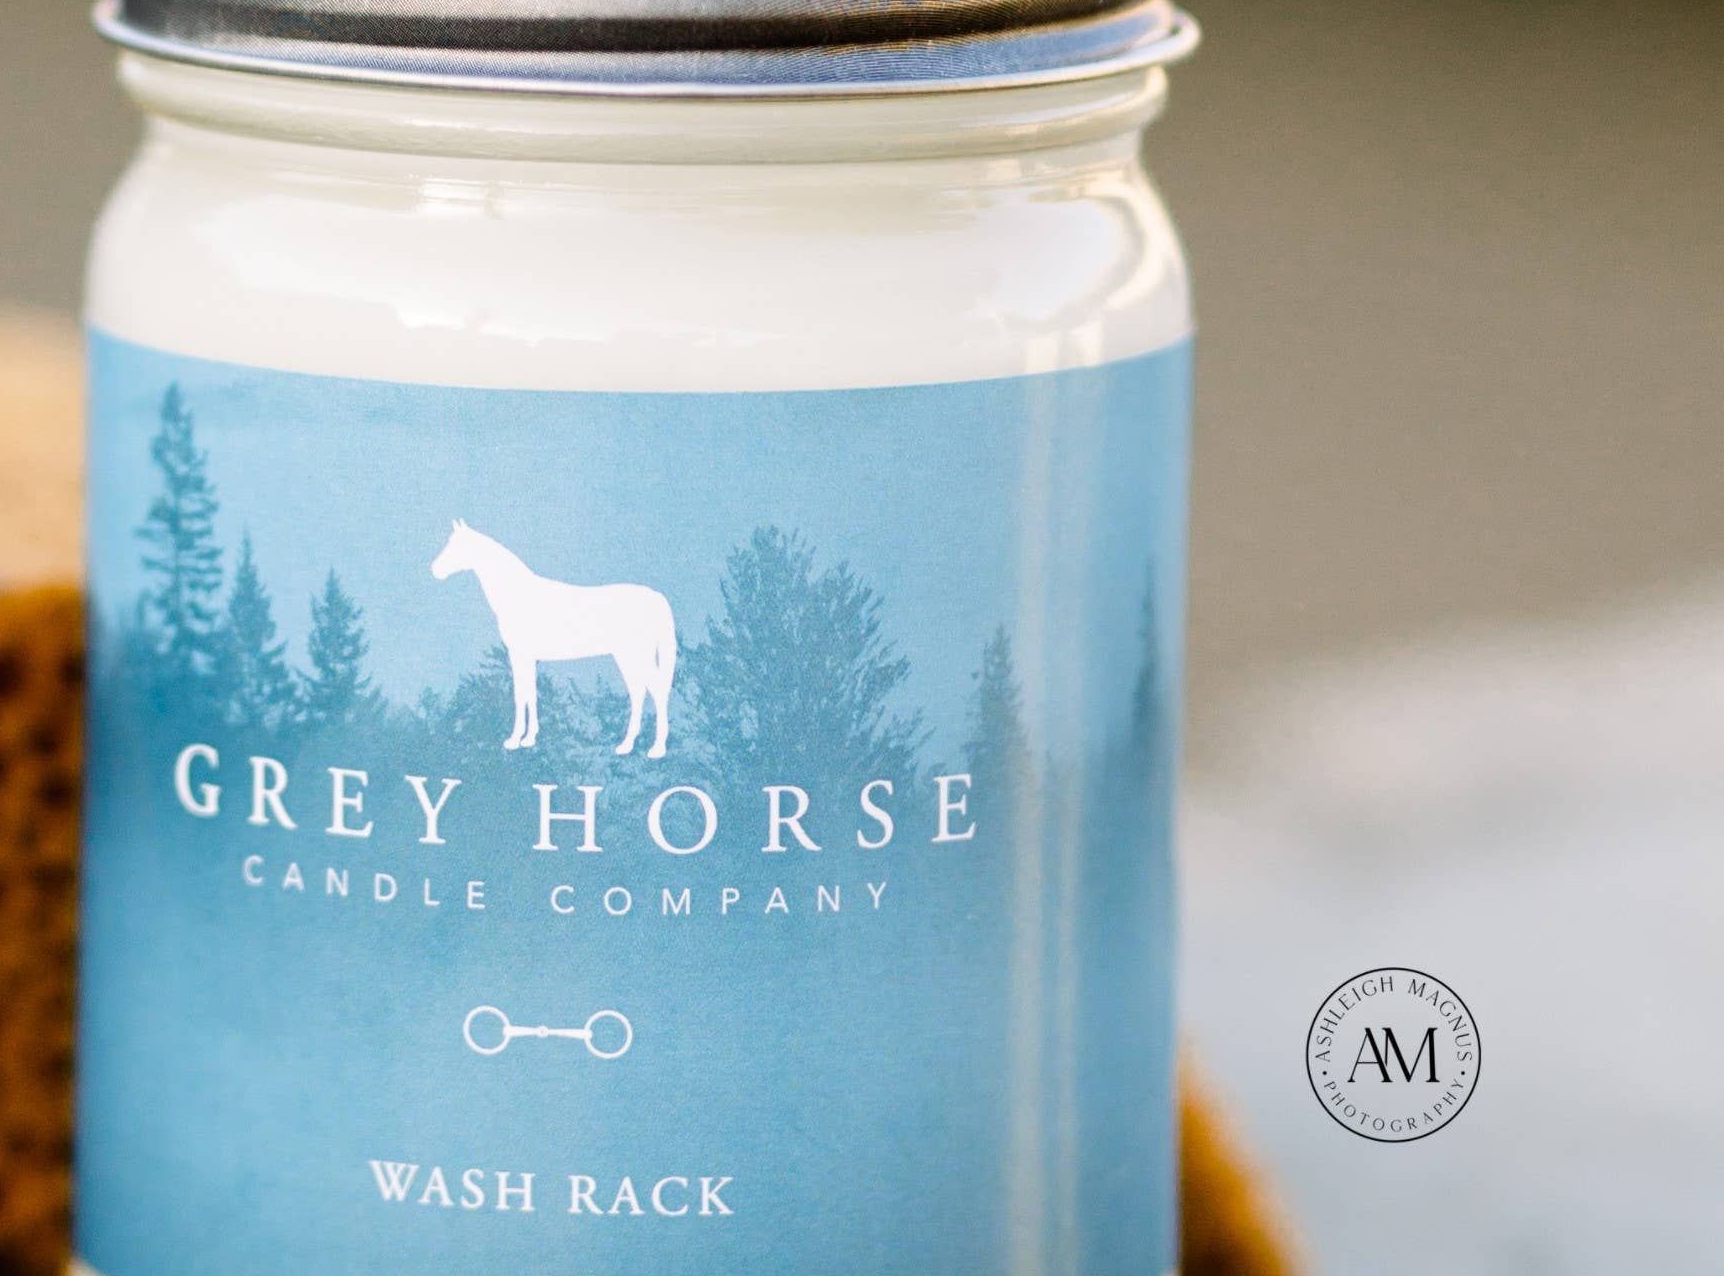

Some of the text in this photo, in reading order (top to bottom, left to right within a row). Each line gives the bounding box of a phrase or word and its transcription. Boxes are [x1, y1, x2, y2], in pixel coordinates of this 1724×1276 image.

[173, 742, 977, 856] GREY HORSE
[242, 854, 889, 916] CANDLE COMPANY
[368, 1158, 735, 1217] WASH RACK
